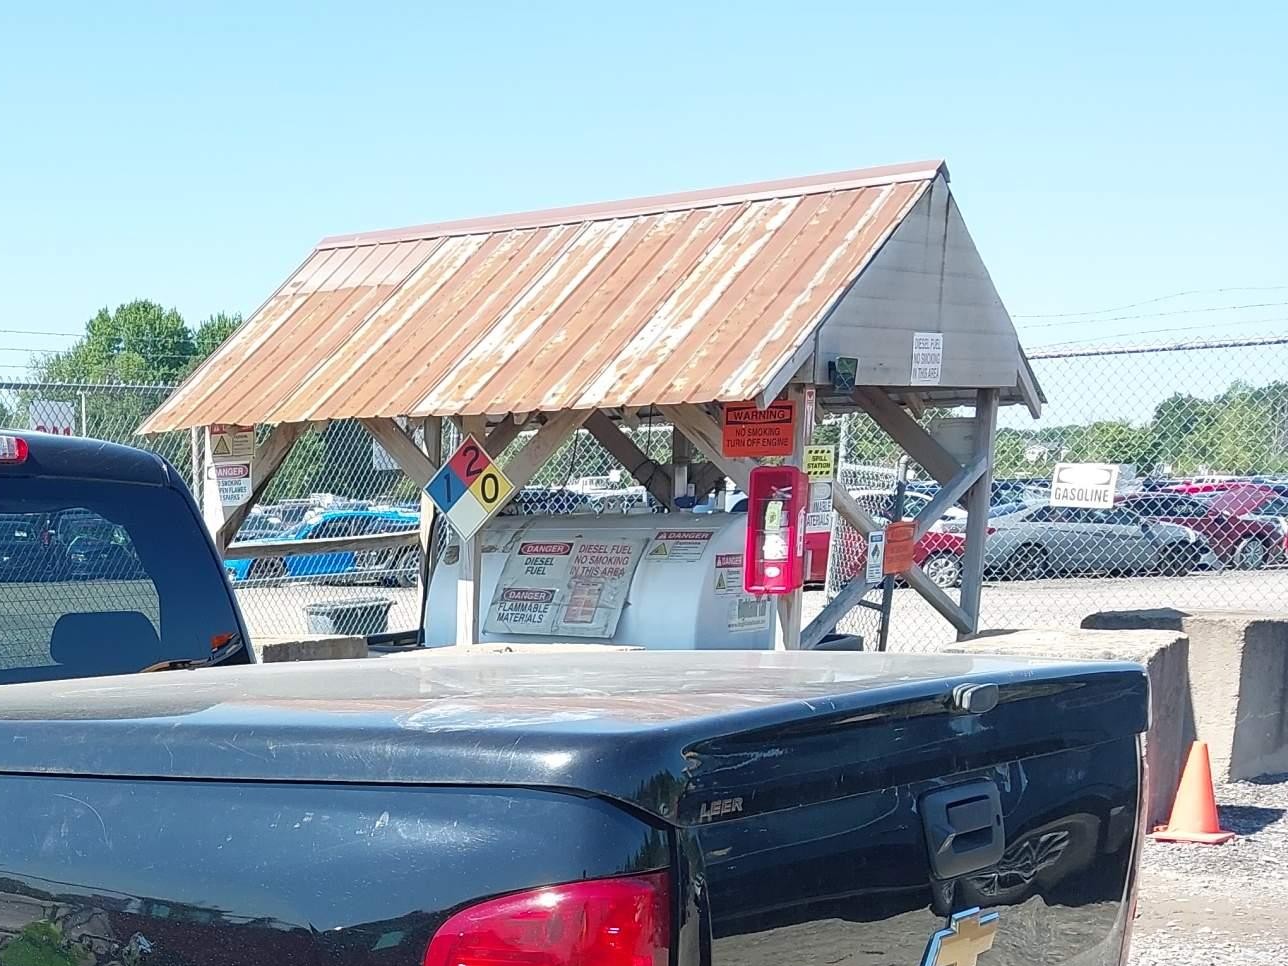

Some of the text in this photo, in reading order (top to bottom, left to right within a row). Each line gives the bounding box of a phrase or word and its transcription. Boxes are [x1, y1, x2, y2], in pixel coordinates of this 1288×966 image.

[734, 410, 785, 420] WARNING
[735, 428, 780, 437] NO SMOKING
[727, 440, 745, 448] TURN
[760, 439, 789, 447] ENGINE
[462, 446, 482, 477] 2
[807, 462, 830, 470] STATION
[444, 473, 452, 503] 1
[481, 473, 499, 503] 0
[1055, 487, 1109, 503] GASOLINE
[806, 513, 830, 527] ATERIALS
[527, 544, 564, 553] DANGER
[579, 544, 632, 555] DIESEL FUEL
[524, 557, 554, 566] DIESEL
[574, 555, 630, 565] NO SMOKING
[524, 566, 546, 575] FUEL
[569, 566, 626, 577] IN THIS AREA
[508, 592, 547, 600] DANGER
[497, 603, 549, 613] FLAMMABLE
[496, 612, 544, 623] MATERIALS
[700, 797, 743, 818] LEER
